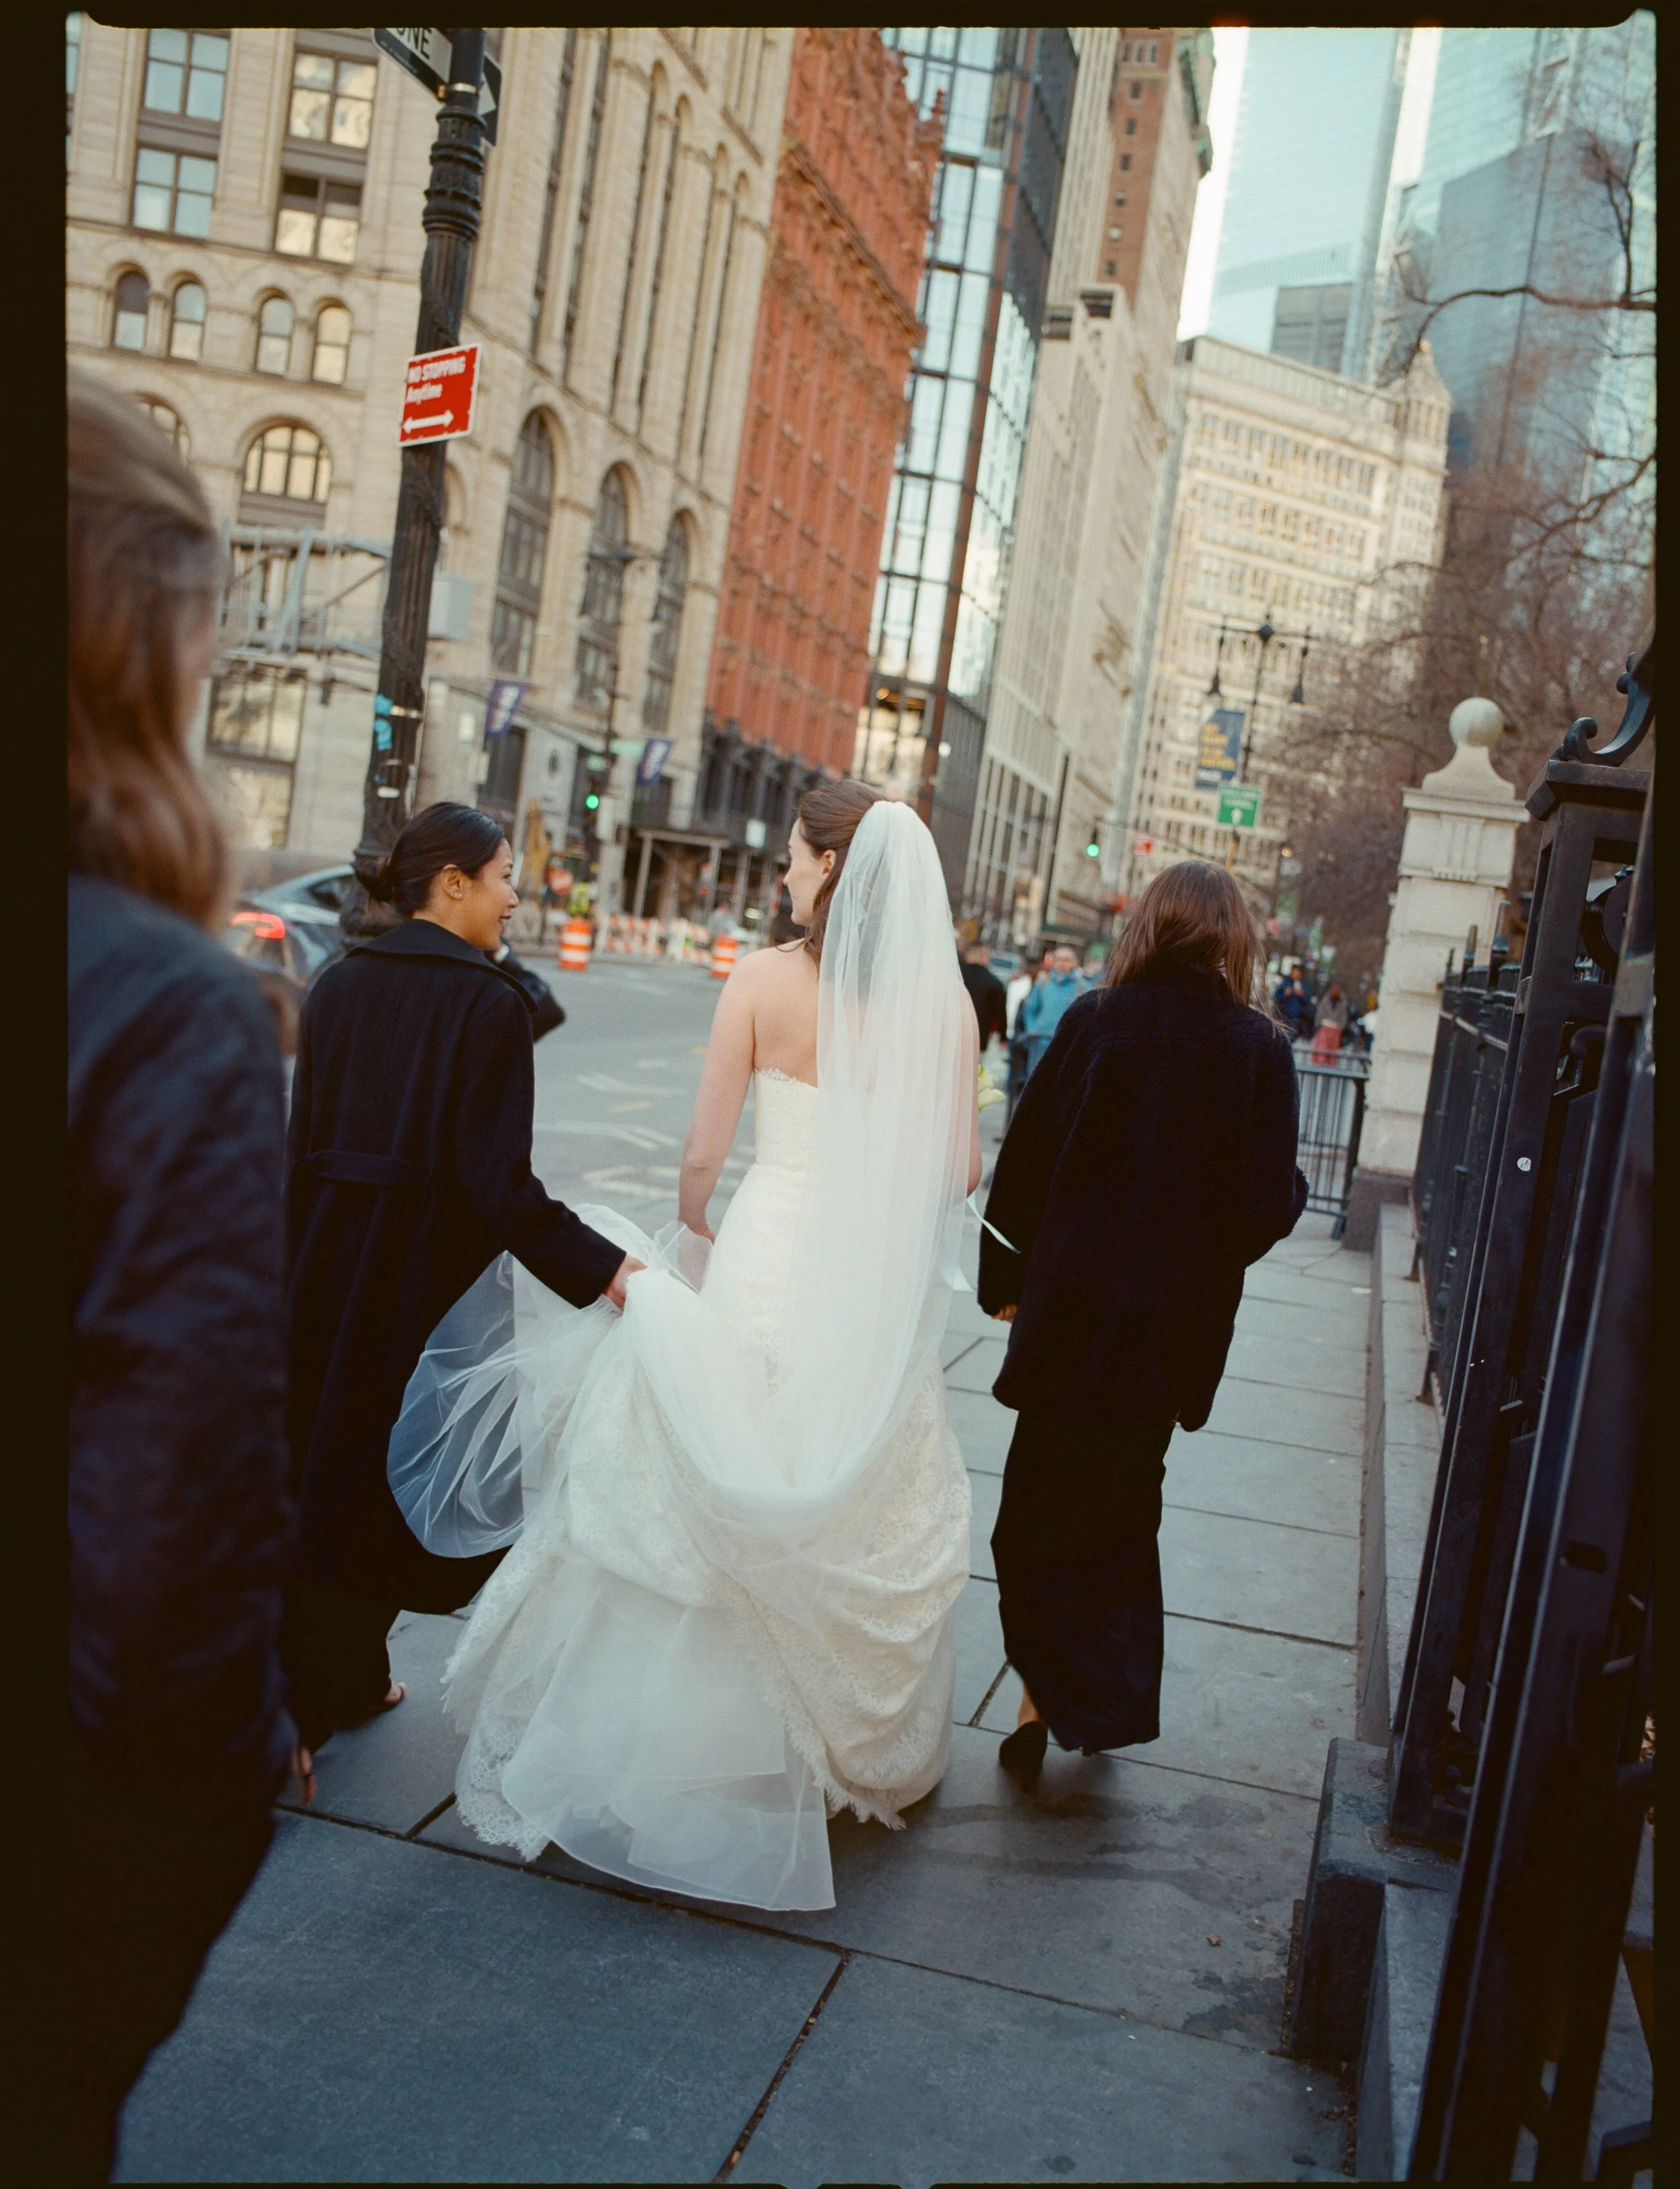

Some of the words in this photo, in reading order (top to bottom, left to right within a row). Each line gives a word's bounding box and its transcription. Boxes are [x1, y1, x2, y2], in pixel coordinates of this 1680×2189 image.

[397, 28, 431, 59] NE
[408, 366, 421, 383] NO
[422, 356, 466, 381] STOPPING
